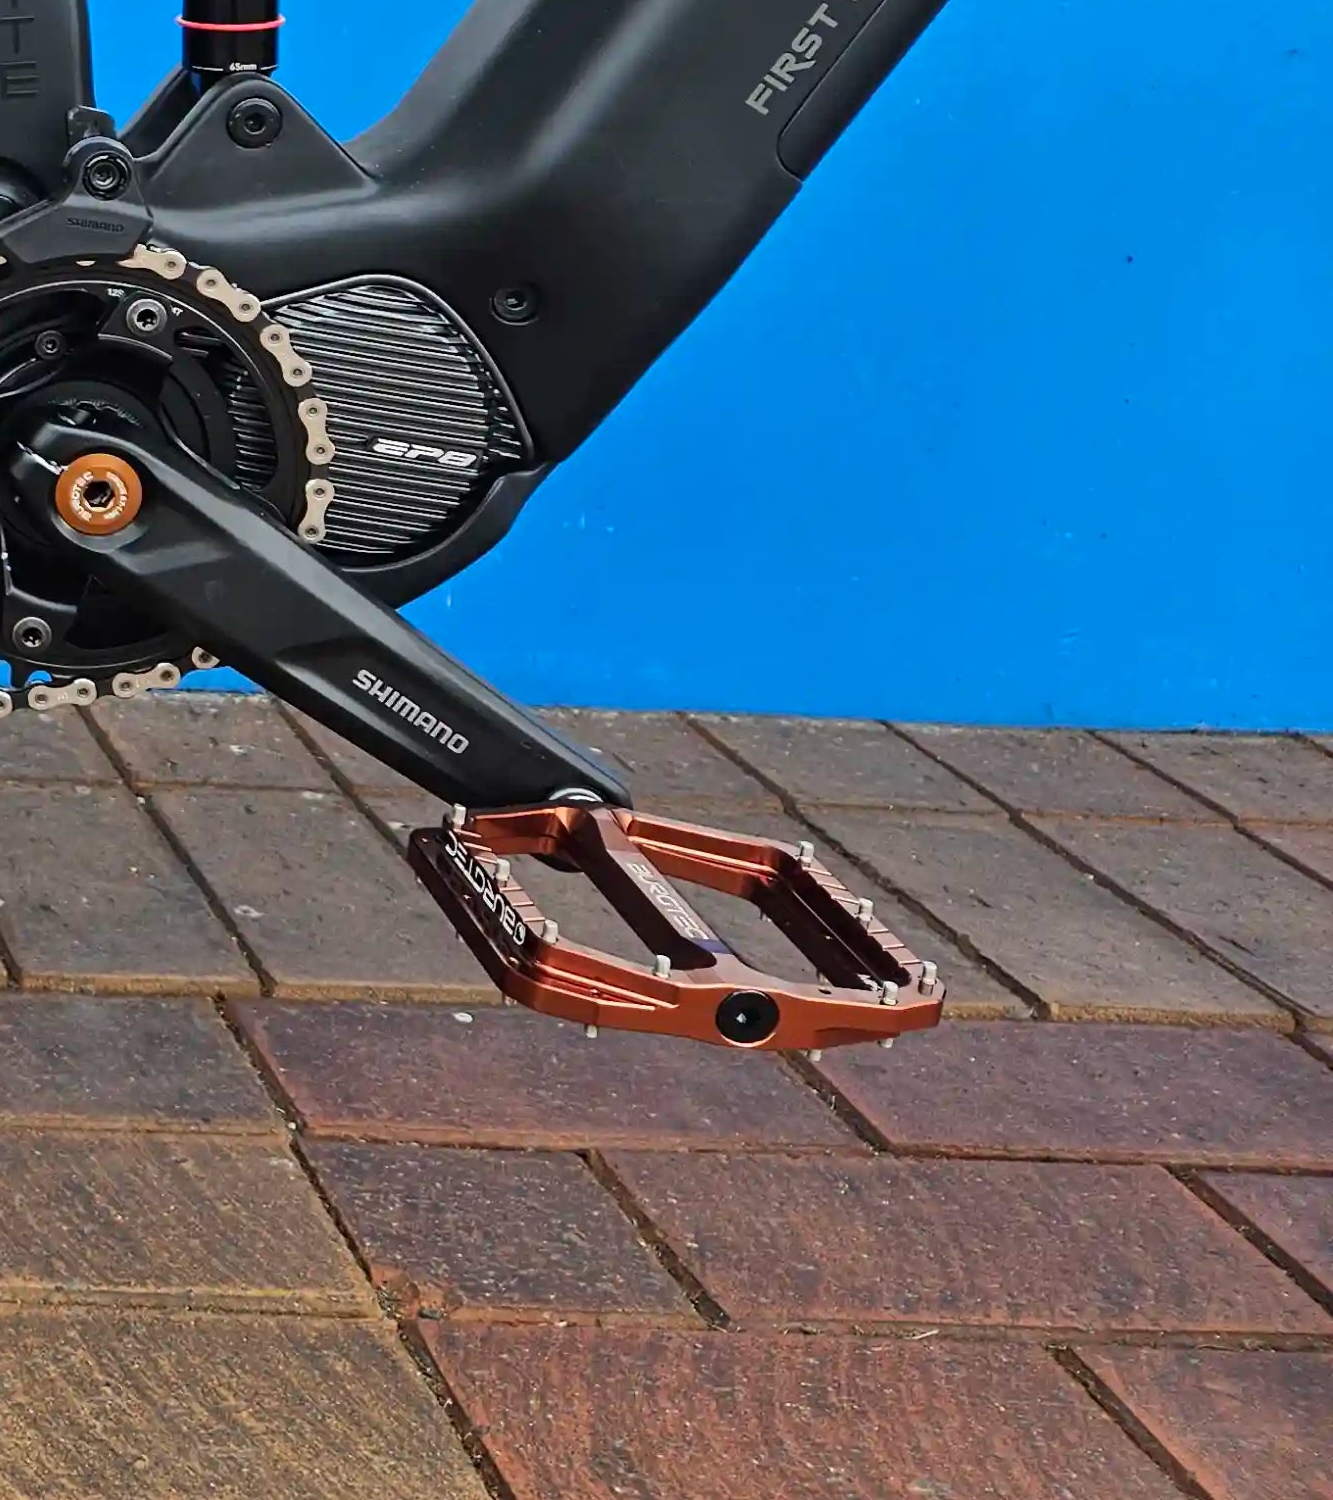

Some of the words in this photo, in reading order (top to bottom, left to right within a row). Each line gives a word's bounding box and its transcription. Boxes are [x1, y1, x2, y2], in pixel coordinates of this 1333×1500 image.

[744, 2, 838, 115] FIRST
[66, 217, 125, 233] SHIMANO
[352, 669, 470, 754] SHIMANO
[626, 862, 710, 940] BURGTEC
